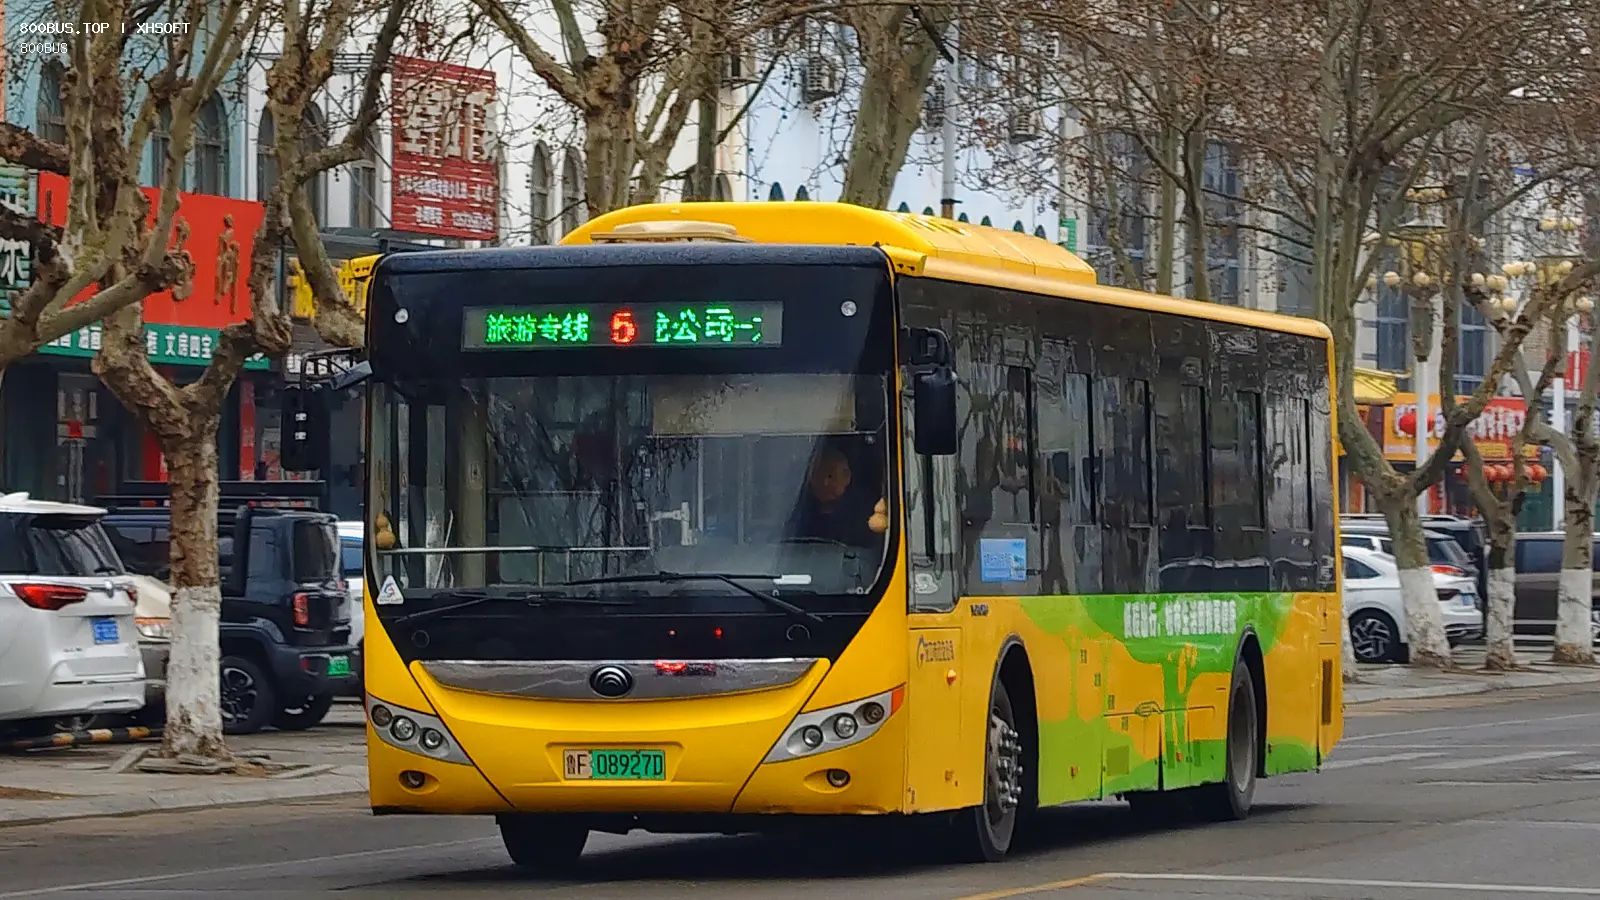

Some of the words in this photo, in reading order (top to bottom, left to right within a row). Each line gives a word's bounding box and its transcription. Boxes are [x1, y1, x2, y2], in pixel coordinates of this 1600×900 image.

[486, 312, 589, 343] 旅游专线
[611, 310, 636, 343] 5
[597, 753, 663, 776] 08927D
